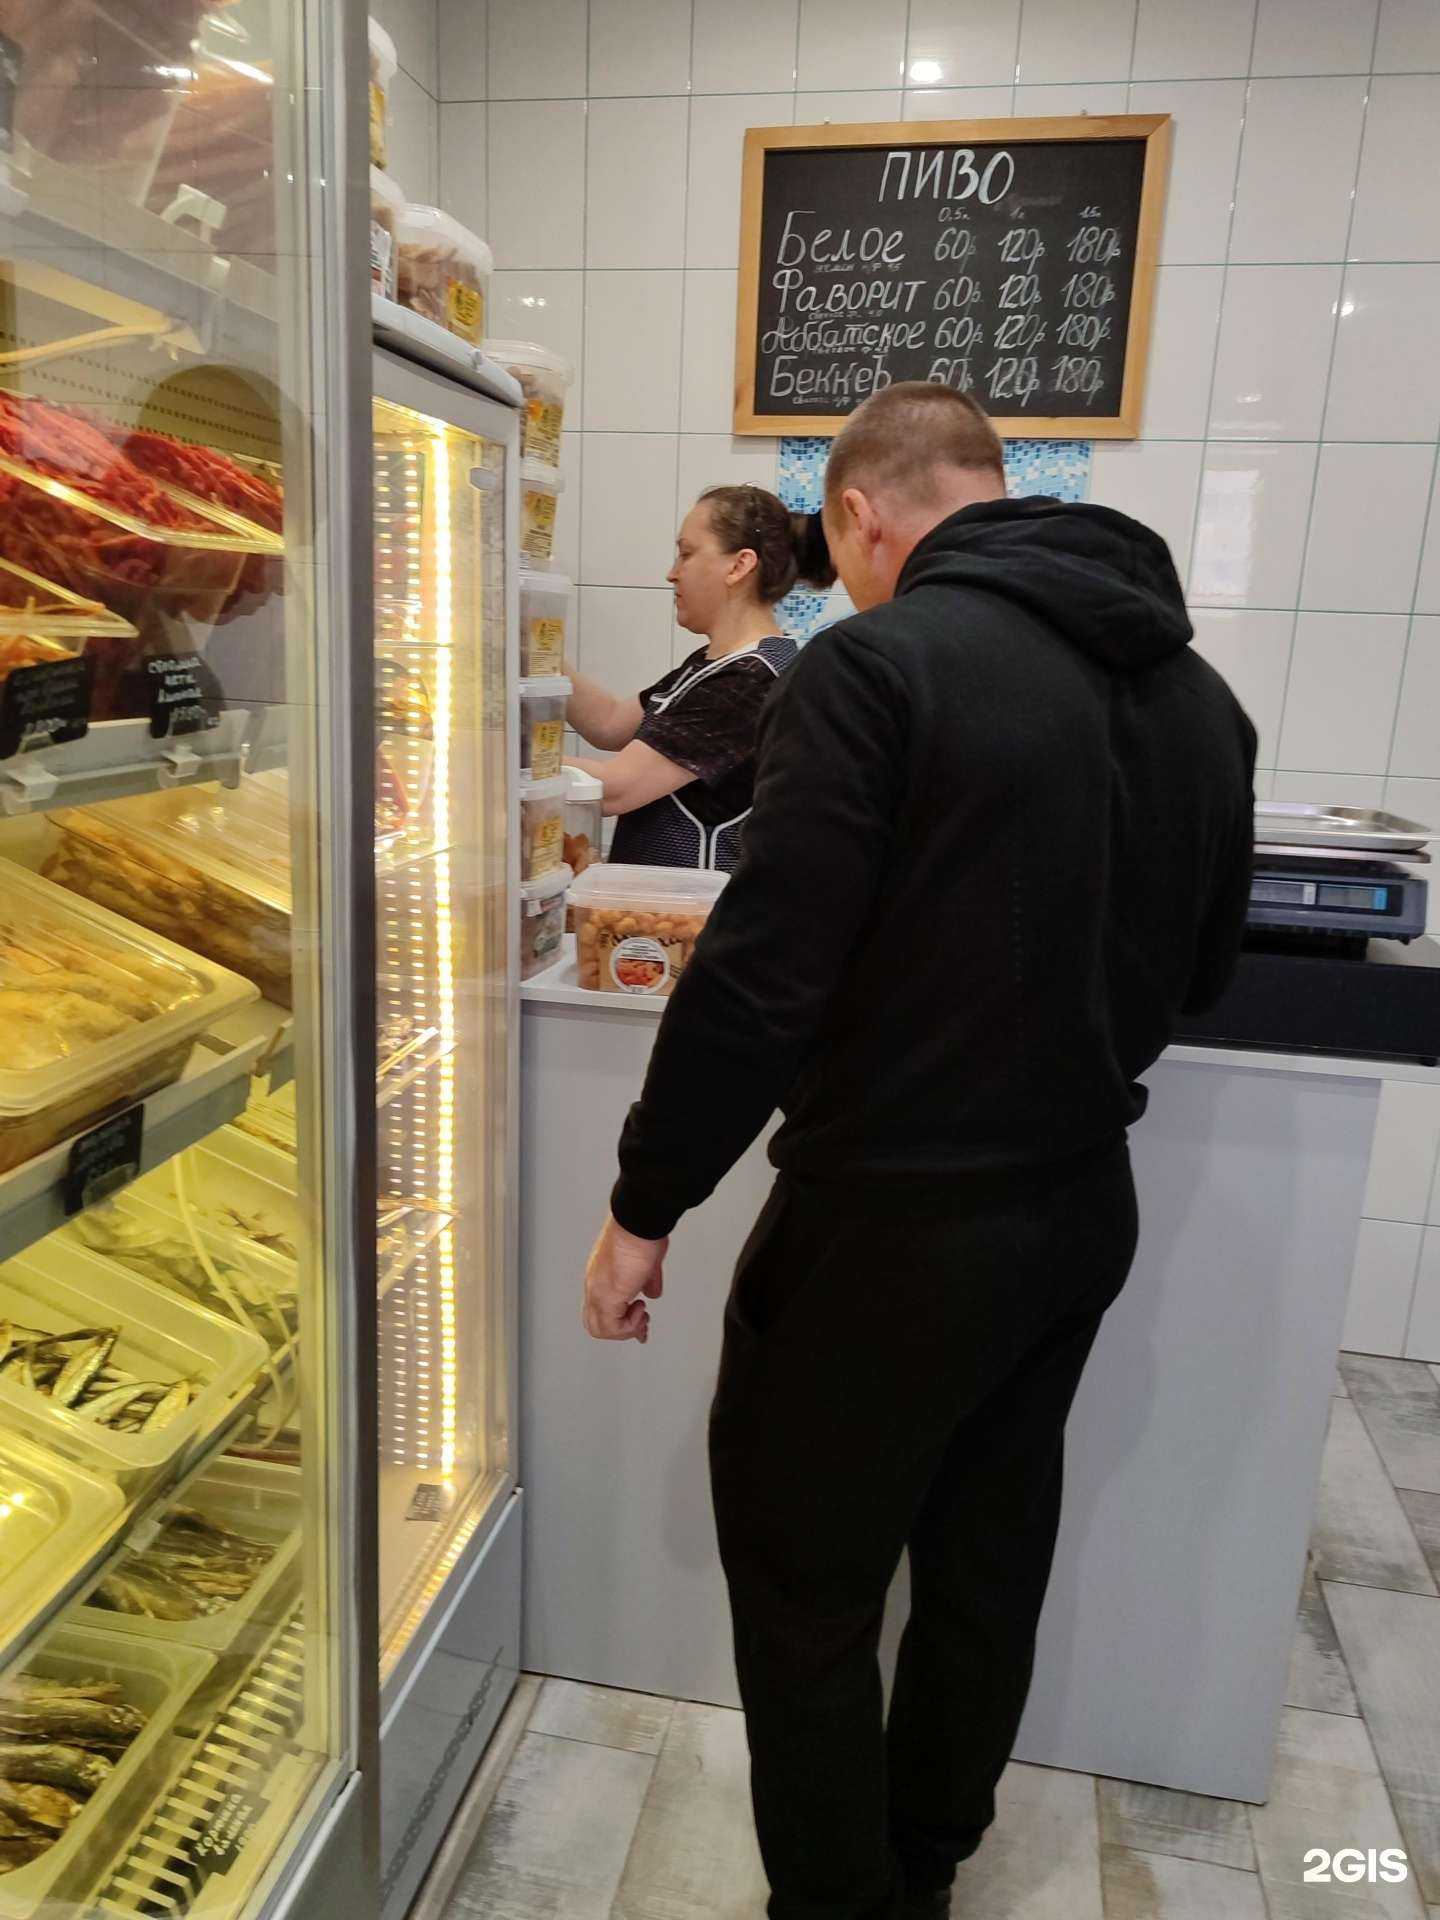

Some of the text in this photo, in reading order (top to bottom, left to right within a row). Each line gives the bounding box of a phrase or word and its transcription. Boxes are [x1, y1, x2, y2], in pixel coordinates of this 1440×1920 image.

[878, 149, 1015, 204] ПИВО
[777, 210, 906, 266] Белое
[773, 269, 928, 313] Фаворит
